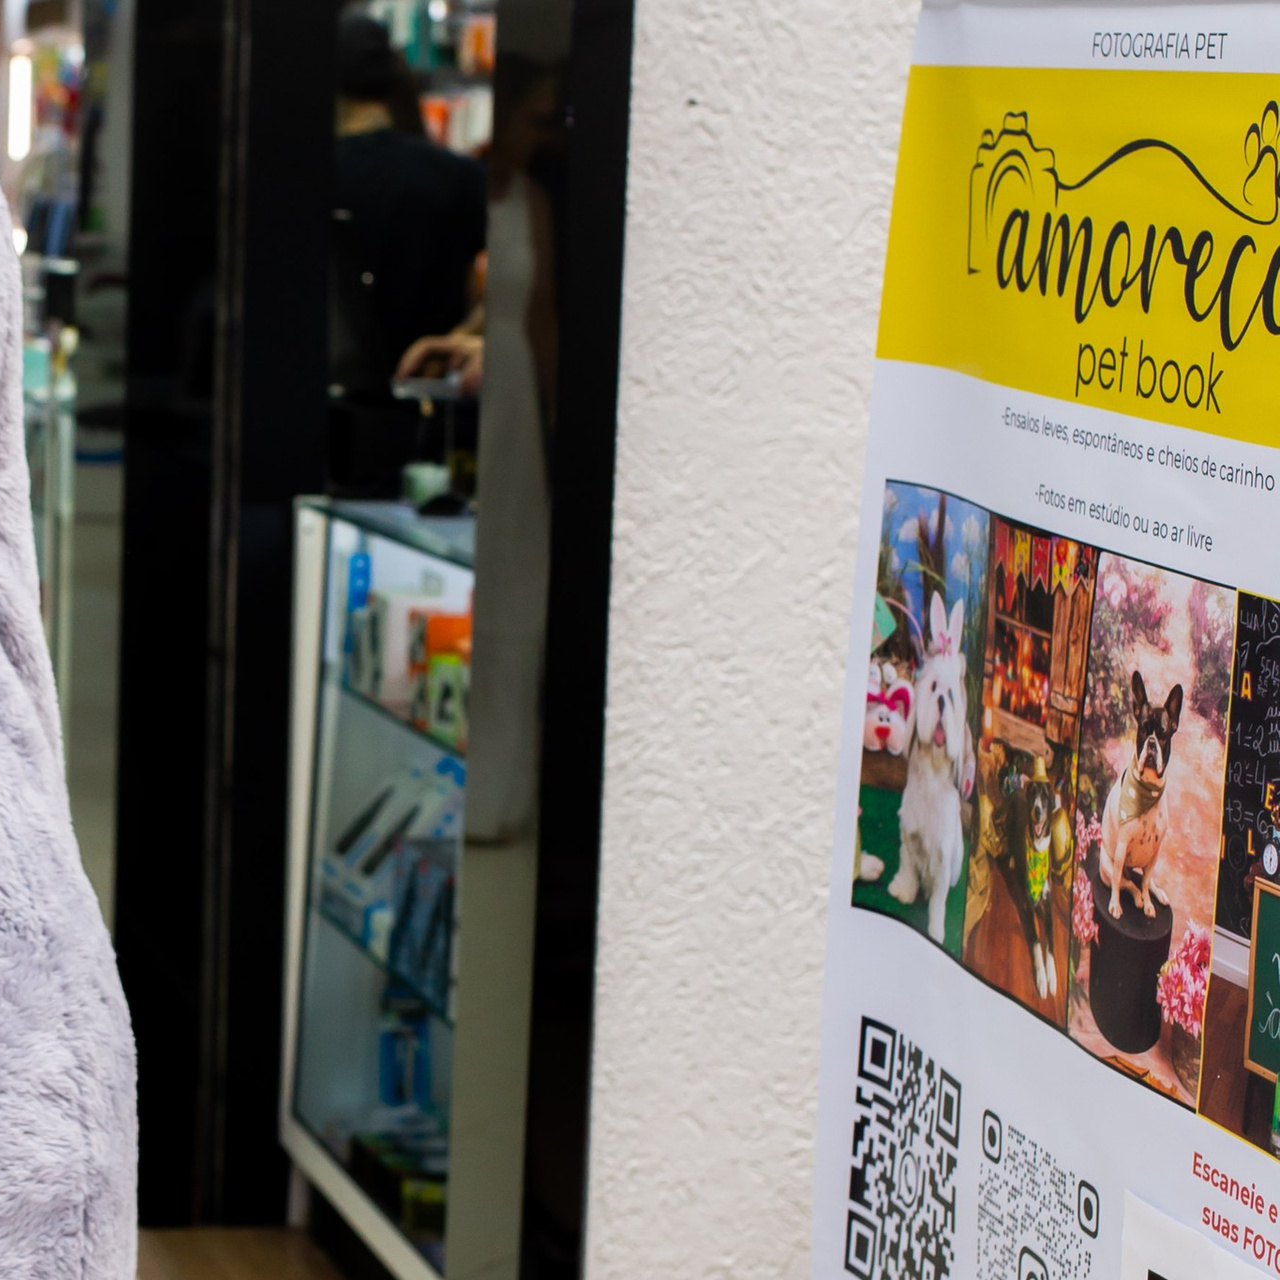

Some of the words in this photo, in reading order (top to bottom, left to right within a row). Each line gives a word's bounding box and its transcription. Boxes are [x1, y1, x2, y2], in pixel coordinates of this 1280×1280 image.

[1092, 32, 1190, 59] FOTOGRAFIA
[1194, 32, 1228, 60] PET
[1075, 336, 1128, 398] pet
[1136, 339, 1224, 414] book
[1042, 416, 1069, 445] leves,
[1072, 427, 1144, 461] espontâneos
[1146, 445, 1155, 463] e
[1158, 444, 1199, 474] cheios
[1201, 454, 1217, 478] de
[1219, 462, 1275, 492] carinho
[1067, 497, 1086, 516] em
[1089, 503, 1130, 529] estúdio
[1133, 515, 1149, 534] ou
[1152, 520, 1168, 539] ao
[1170, 526, 1184, 544] ar
[1187, 524, 1213, 552] livre
[1192, 1151, 1265, 1215] Escaneie
[1268, 1204, 1278, 1224] e
[1202, 1206, 1239, 1244] suas
